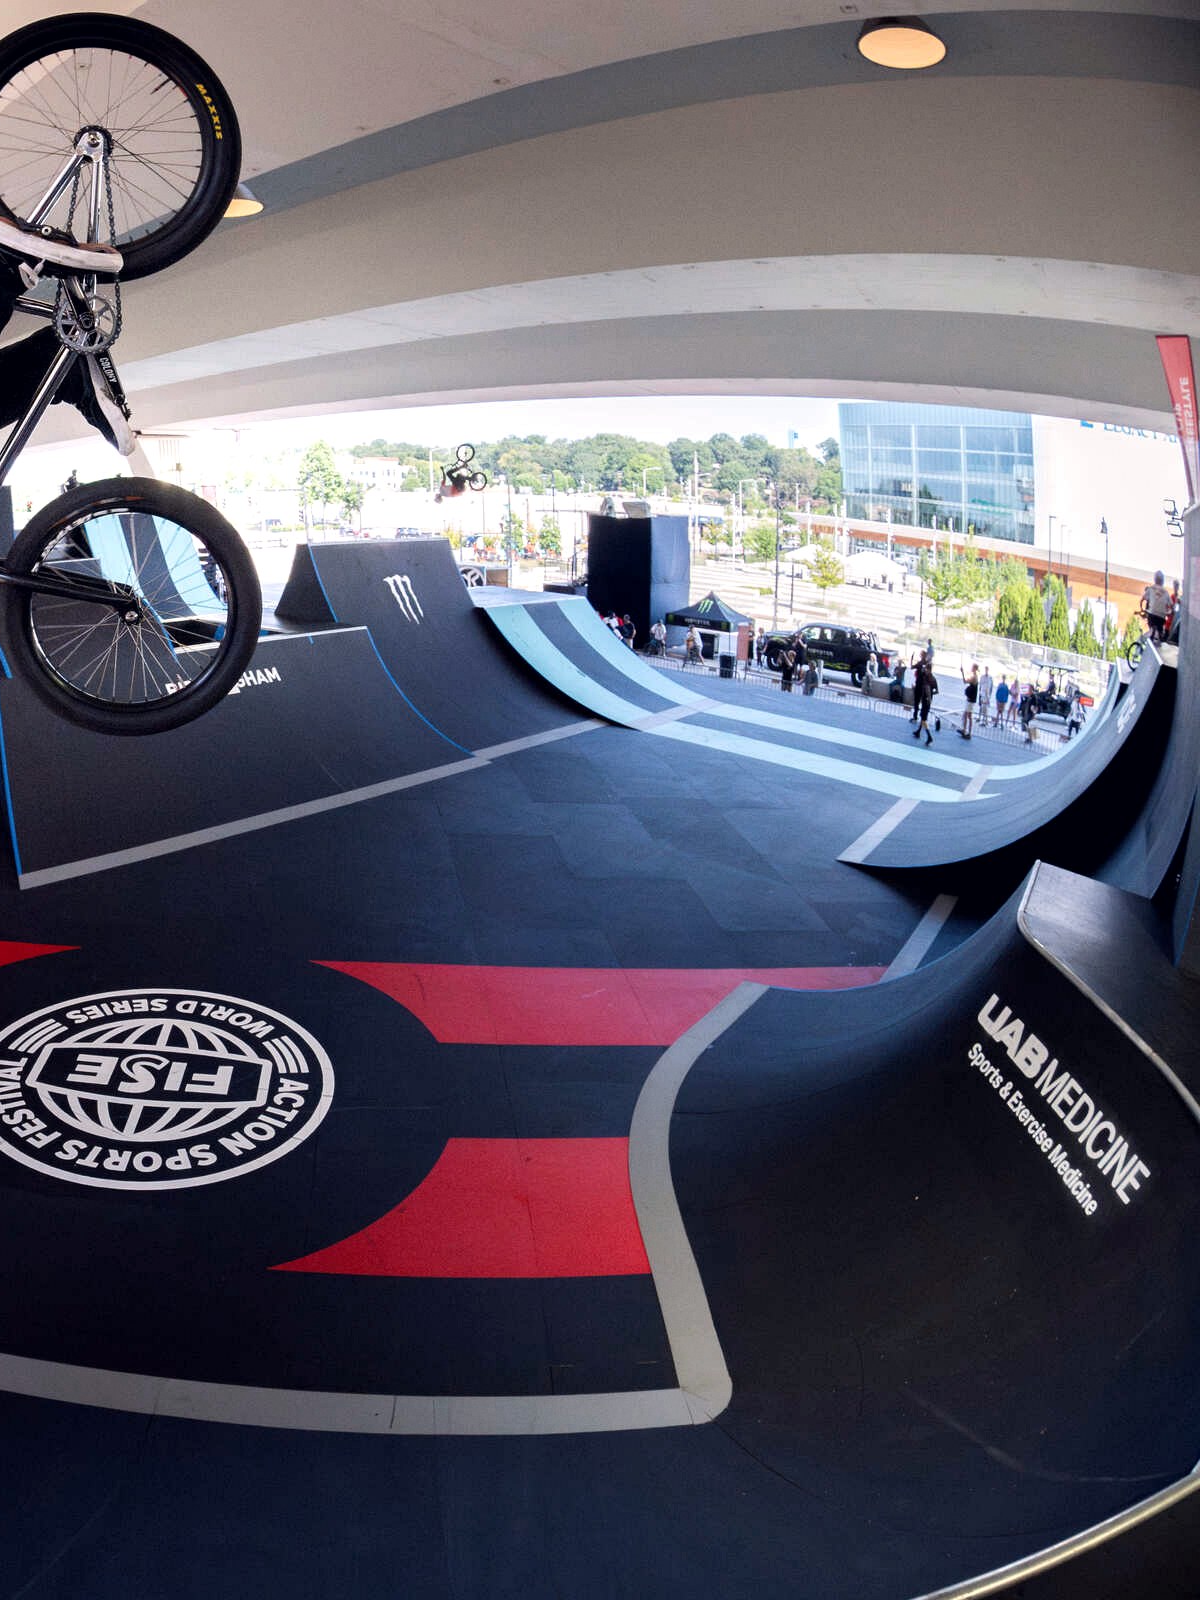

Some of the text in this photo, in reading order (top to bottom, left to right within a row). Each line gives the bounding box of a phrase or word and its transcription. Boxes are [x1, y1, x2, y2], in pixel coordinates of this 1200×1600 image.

[195, 83, 223, 140] MAXXIS
[99, 357, 118, 383] COLONY
[66, 999, 275, 1039] WORLD SERIES
[66, 1053, 234, 1096] FISE
[977, 993, 1151, 1205] UAB MEDICINE
[217, 1077, 310, 1156] ACTION
[968, 1042, 1098, 1216] Sports & Exercise Medicine
[54, 1139, 218, 1173] SPORTS
